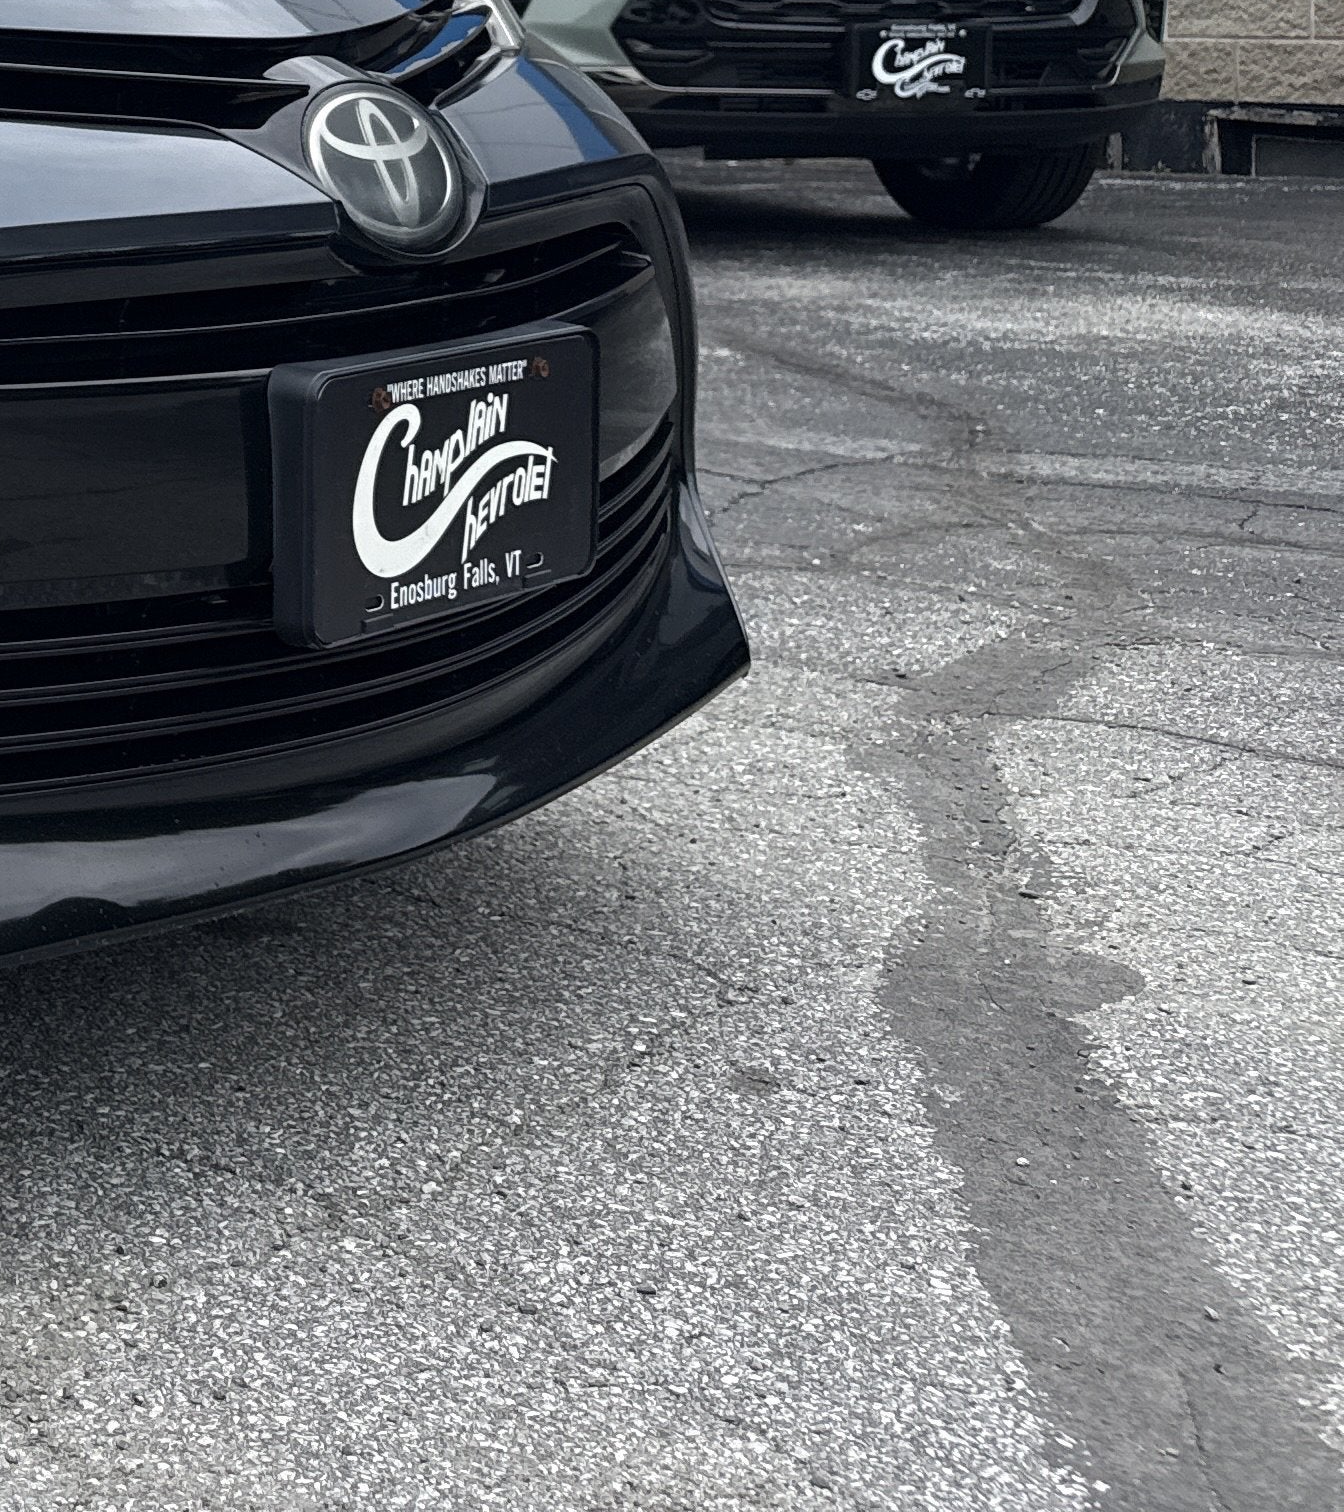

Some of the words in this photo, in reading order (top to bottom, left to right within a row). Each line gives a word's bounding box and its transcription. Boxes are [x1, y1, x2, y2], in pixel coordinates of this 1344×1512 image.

[386, 377, 424, 403] "WHERE
[426, 365, 487, 398] HANDSHAKES
[488, 359, 528, 384] MATTER"
[389, 571, 458, 610] Enosburg
[463, 557, 500, 590] Falls,
[505, 549, 523, 578] VT
